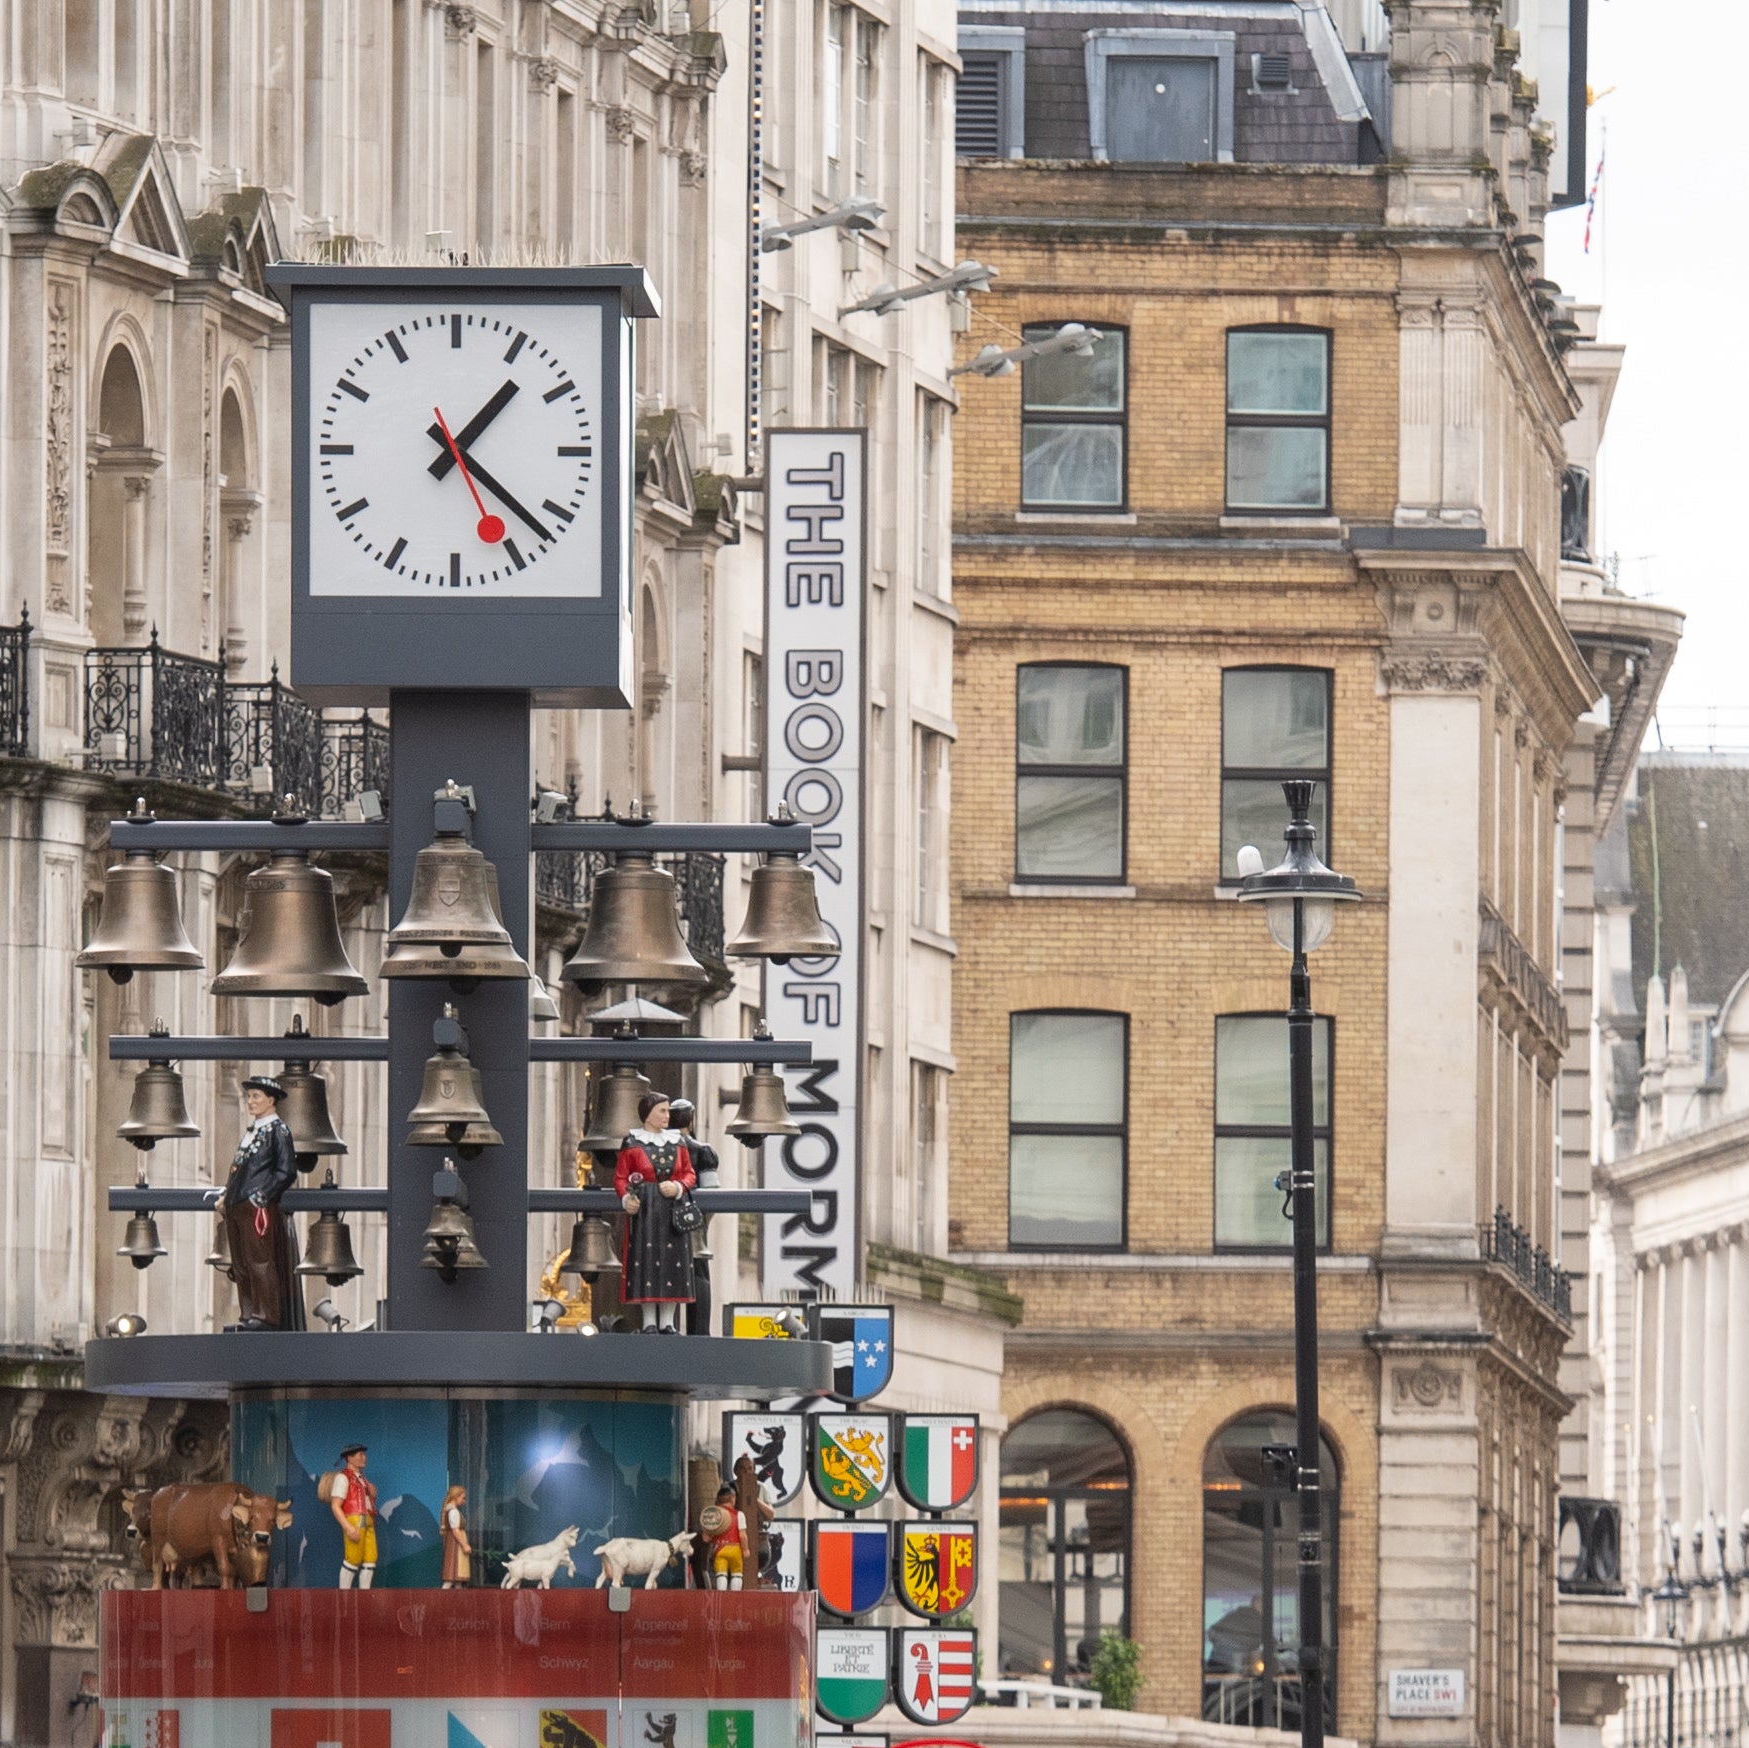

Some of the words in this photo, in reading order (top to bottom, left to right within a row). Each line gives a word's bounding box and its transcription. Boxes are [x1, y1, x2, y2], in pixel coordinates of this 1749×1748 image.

[786, 452, 844, 608] THE
[784, 649, 844, 885] BOOK
[780, 1058, 840, 1300] MORM
[1396, 1674, 1450, 1686] SHAVER'S
[1396, 1689, 1430, 1700] PLACE
